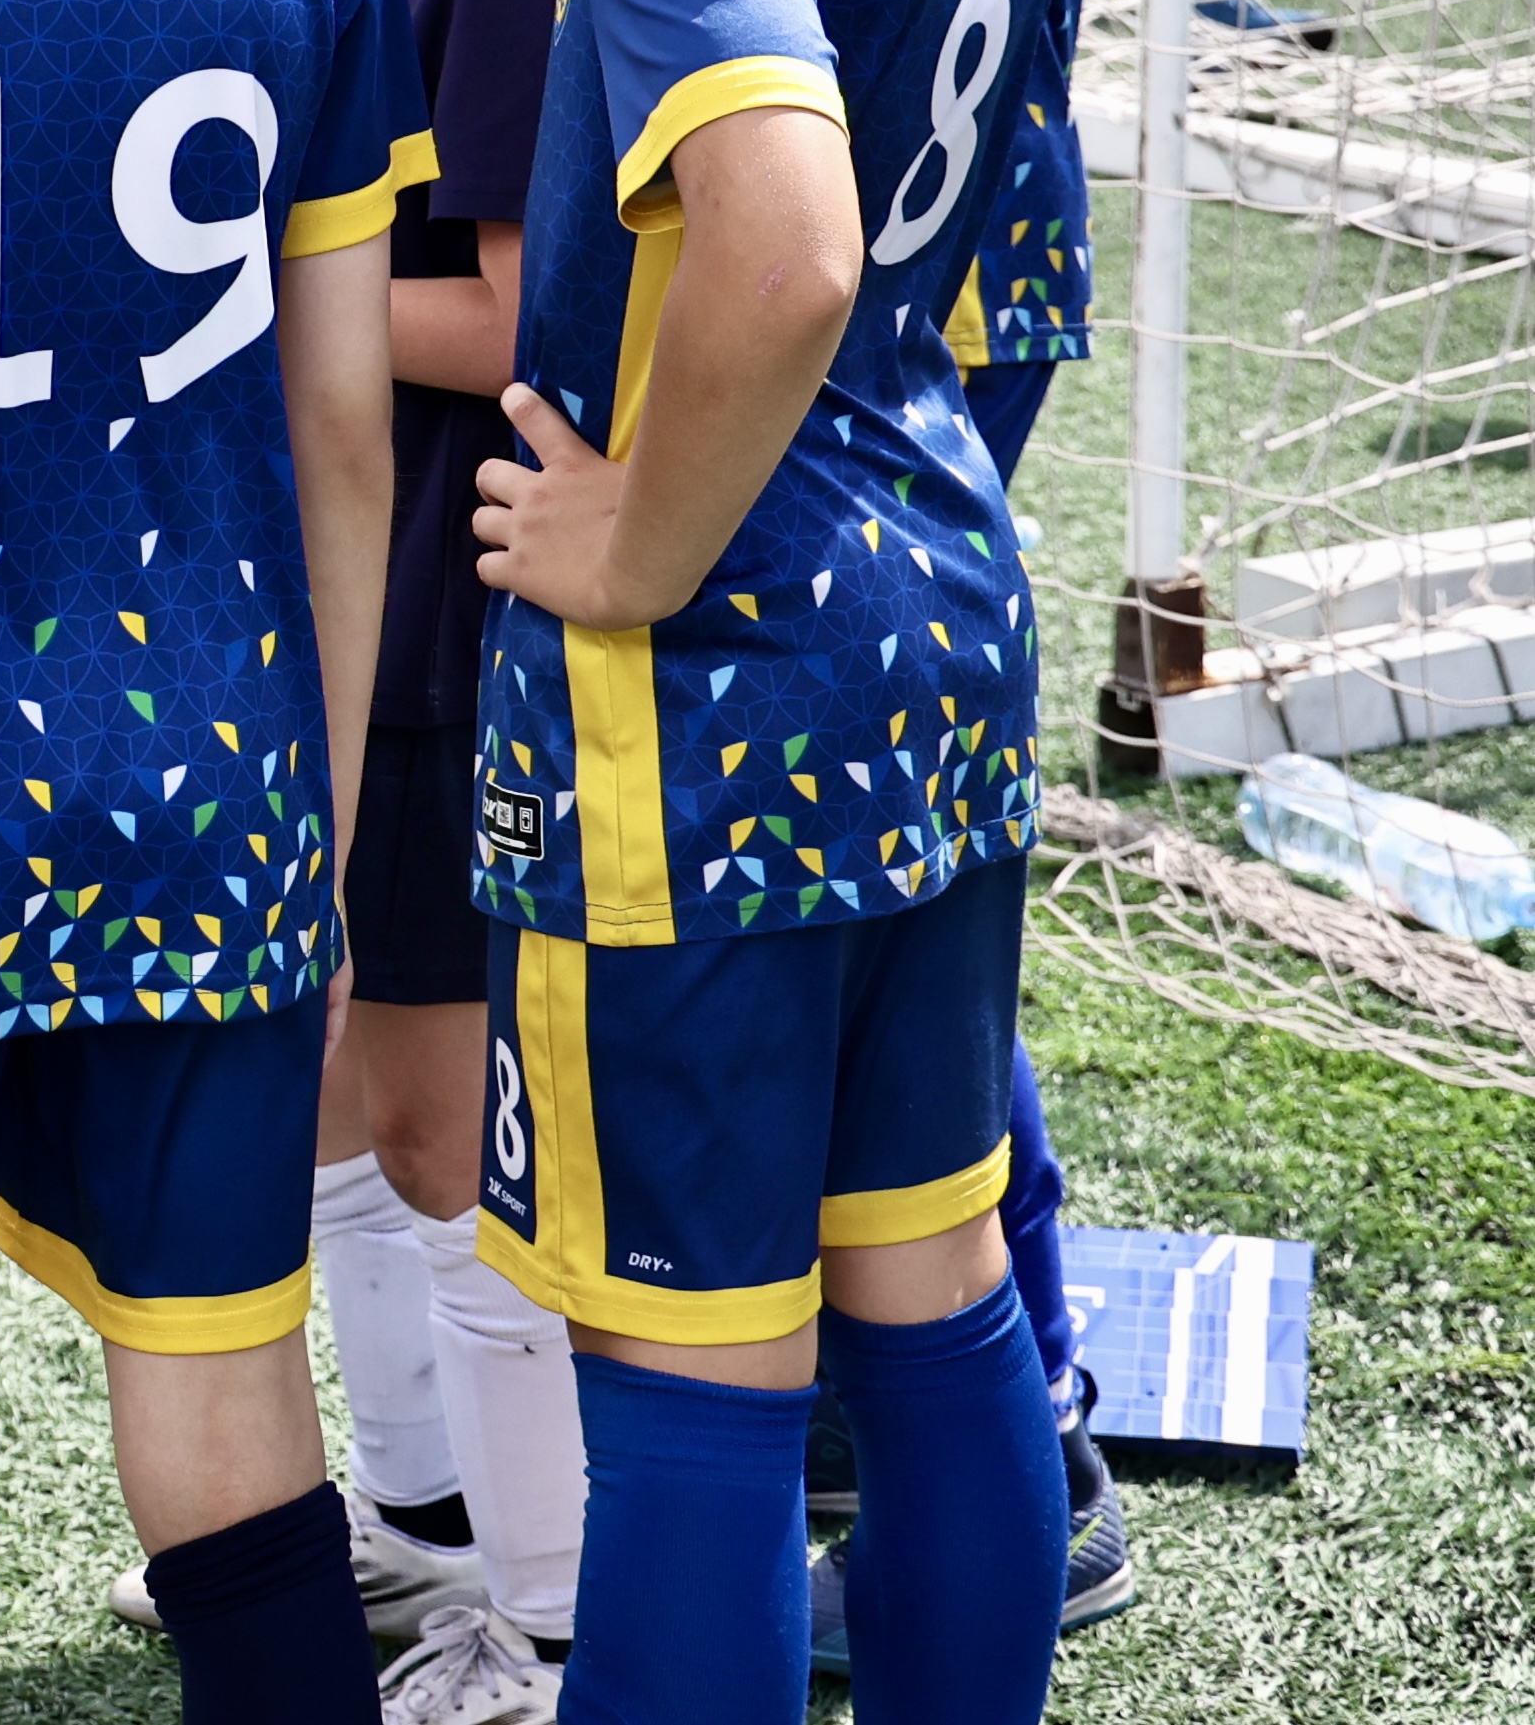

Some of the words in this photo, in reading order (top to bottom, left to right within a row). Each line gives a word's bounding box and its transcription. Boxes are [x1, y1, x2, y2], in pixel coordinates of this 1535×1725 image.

[495, 1036, 526, 1181] 8
[500, 1189, 527, 1217] SPORT
[627, 1251, 674, 1272] DRY+
